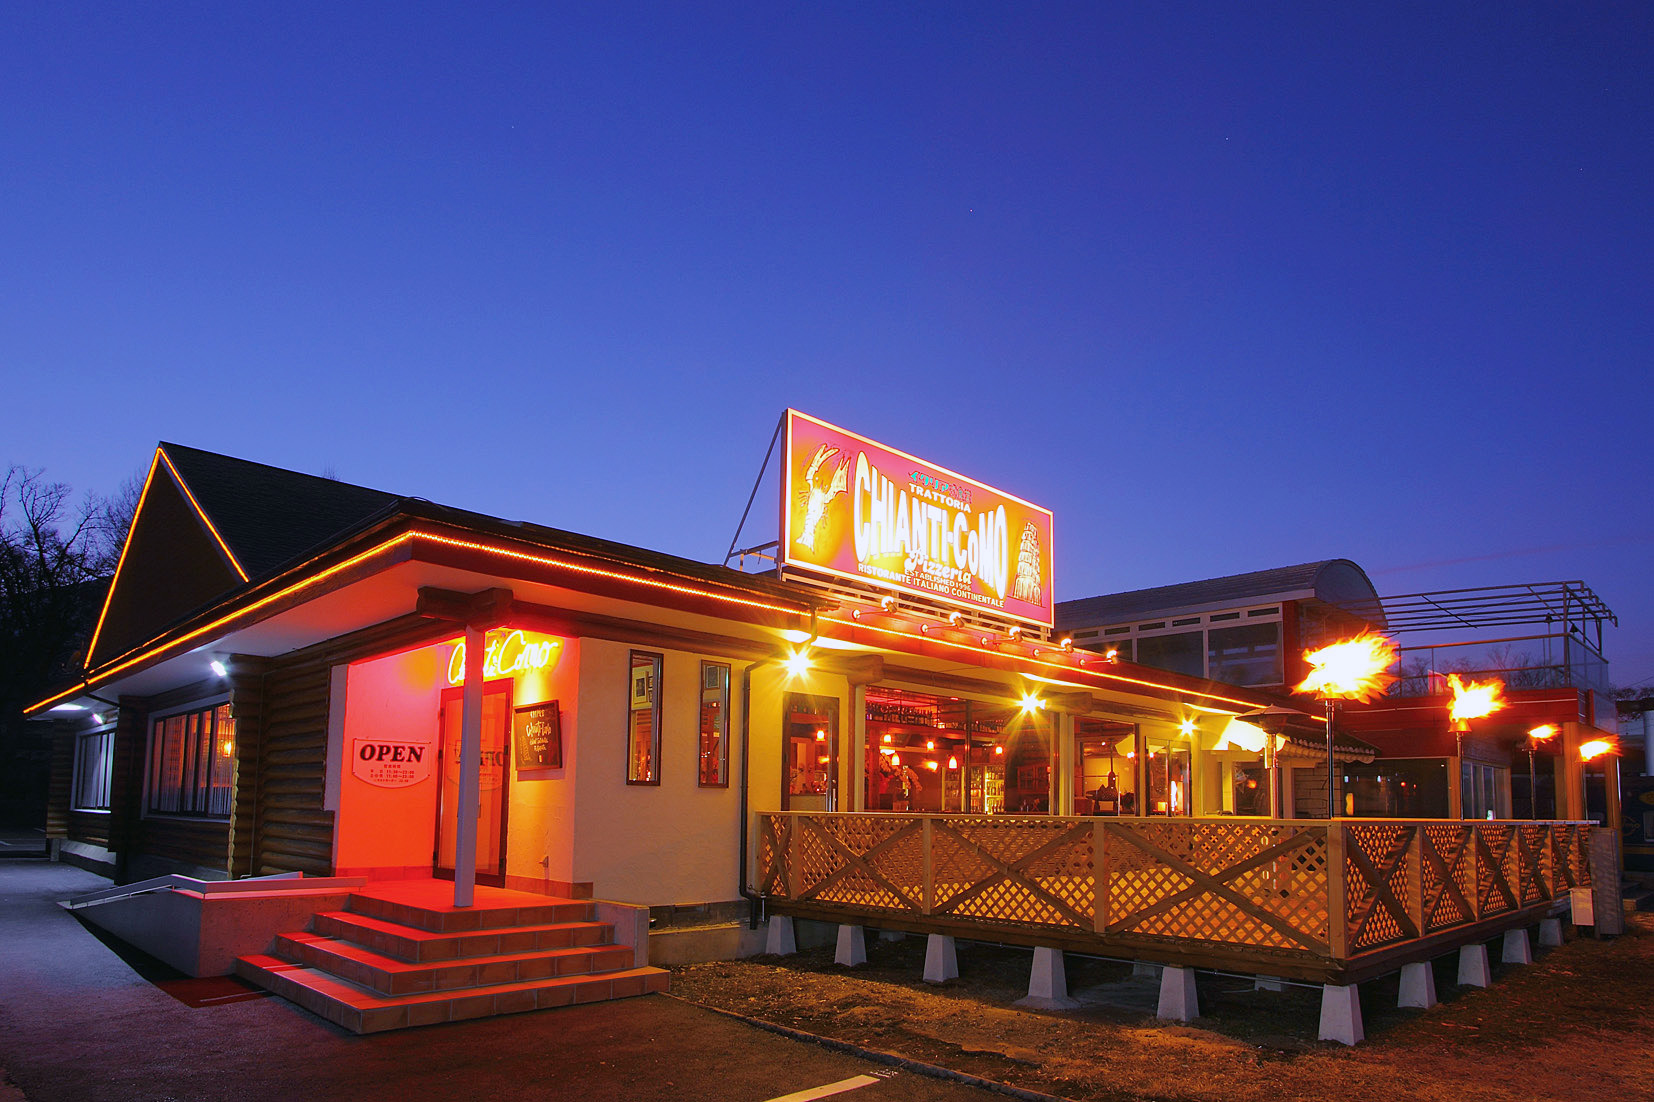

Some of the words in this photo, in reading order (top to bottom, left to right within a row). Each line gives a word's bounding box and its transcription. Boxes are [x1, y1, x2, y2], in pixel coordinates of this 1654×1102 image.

[909, 482, 972, 513] TRATTORIA
[904, 548, 972, 585] Pizzeria
[904, 568, 955, 587] ESTABLISHED
[858, 562, 912, 585] RISTORANTE
[913, 578, 950, 594] ITALIANO
[951, 588, 1005, 608] CONTINENTALE
[360, 744, 425, 763] OPEN
